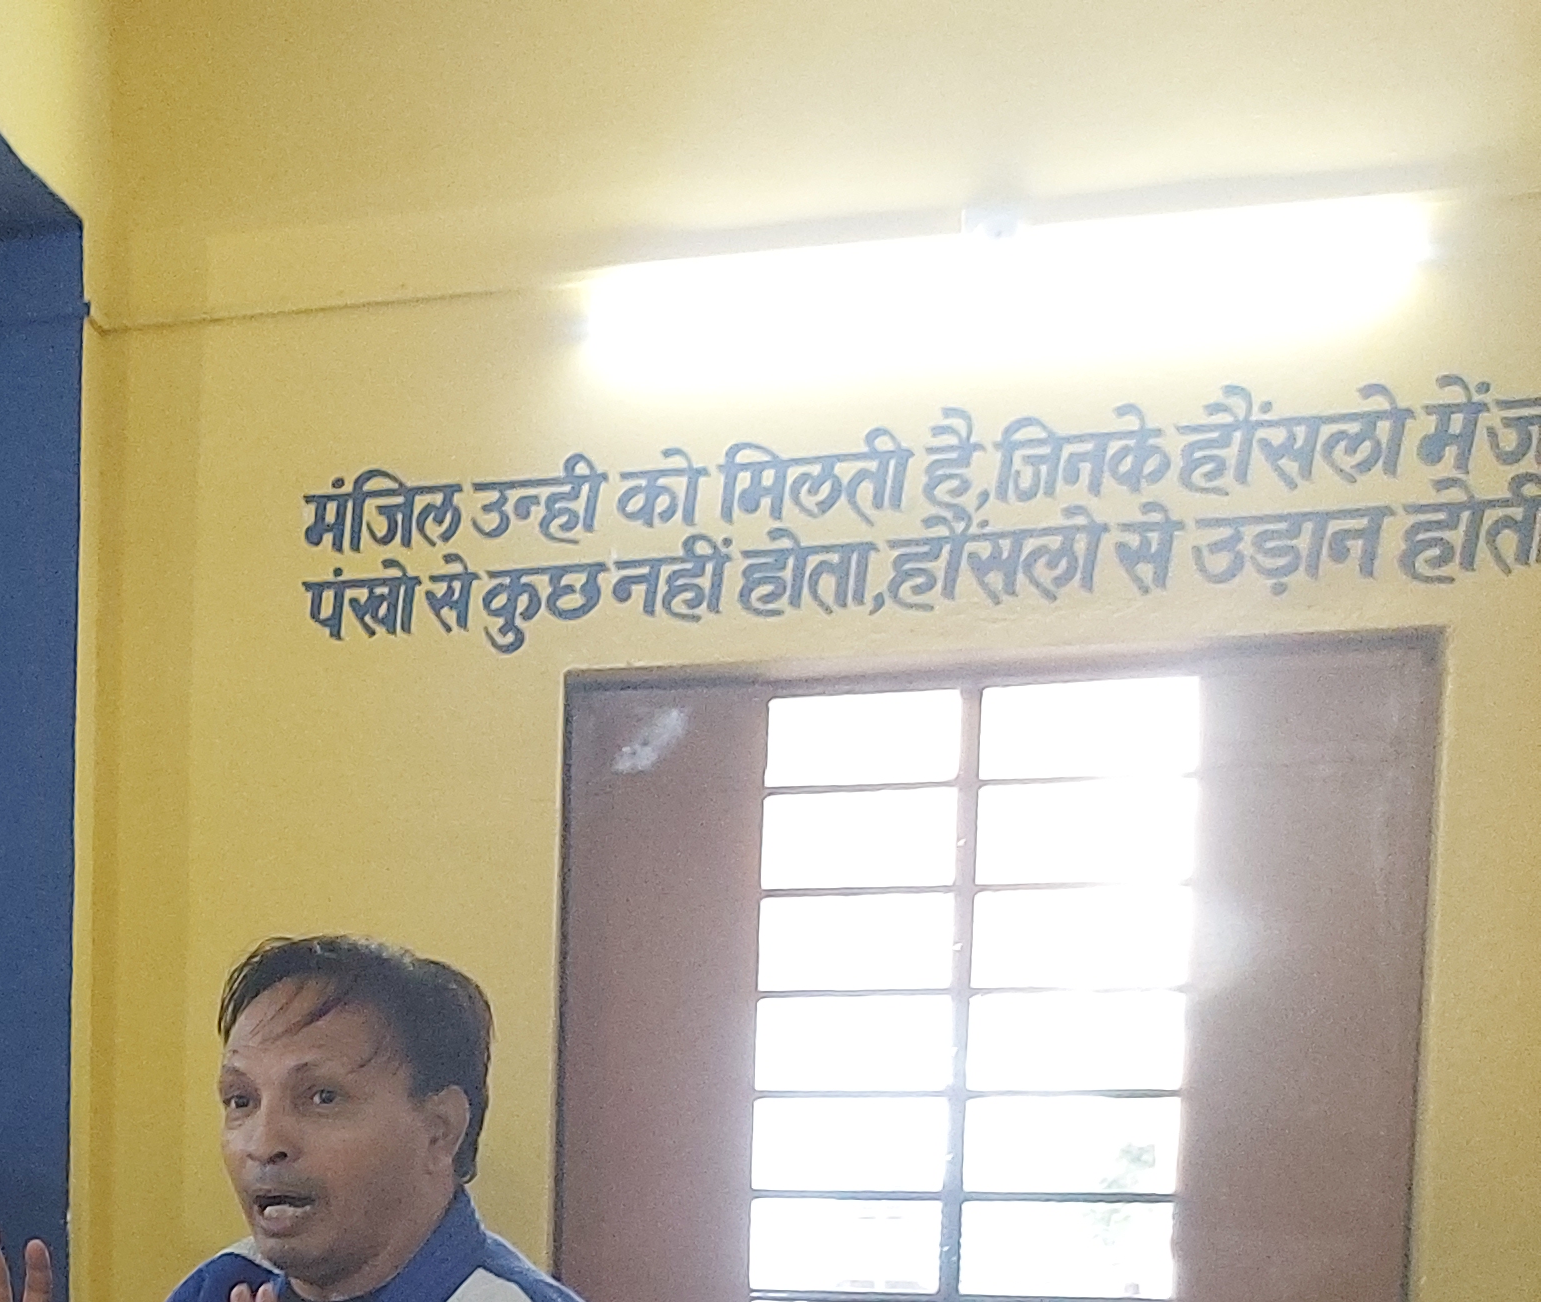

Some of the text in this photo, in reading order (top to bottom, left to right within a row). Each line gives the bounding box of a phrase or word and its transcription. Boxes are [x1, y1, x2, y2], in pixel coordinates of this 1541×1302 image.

[303, 468, 464, 555] मंजिल
[618, 447, 712, 528] को
[717, 426, 916, 527] मिलती
[1416, 374, 1490, 474] में
[425, 552, 481, 634] से
[481, 560, 609, 655] कुछ
[612, 535, 735, 622] नहीं
[1115, 503, 1185, 598] से
[1193, 505, 1397, 596] उड़ान
